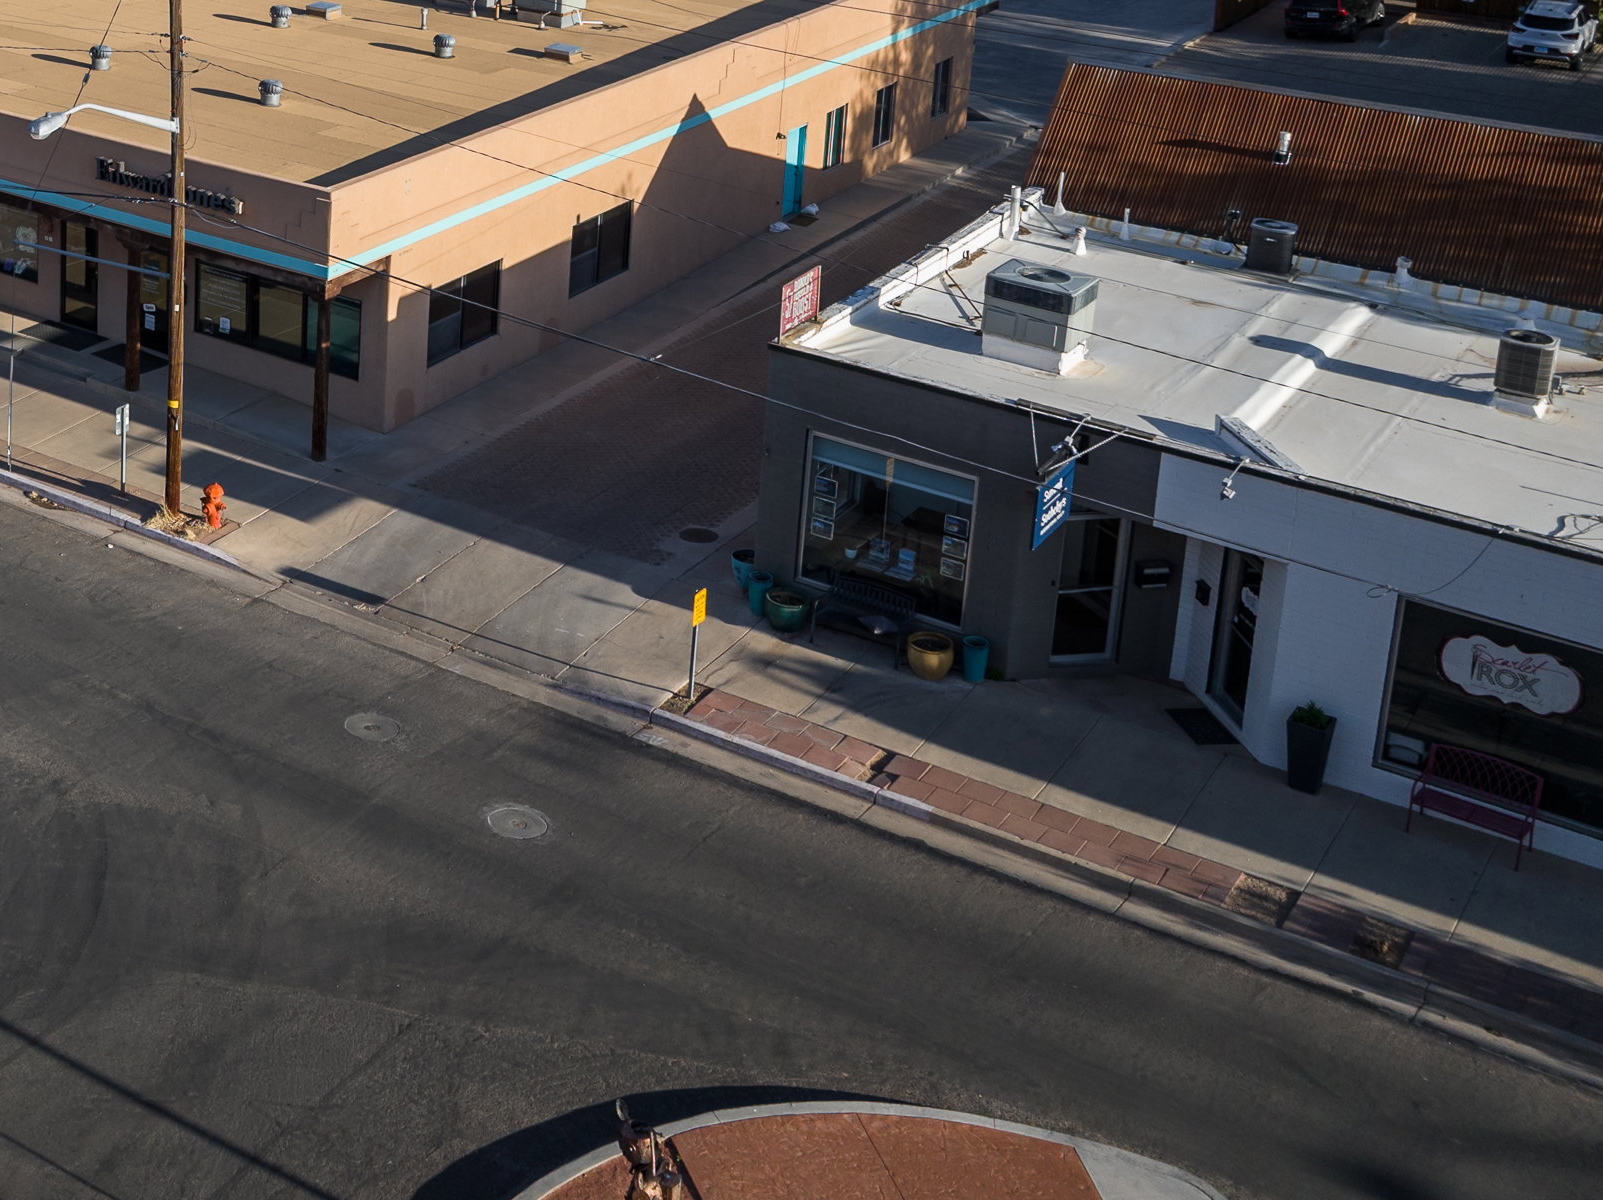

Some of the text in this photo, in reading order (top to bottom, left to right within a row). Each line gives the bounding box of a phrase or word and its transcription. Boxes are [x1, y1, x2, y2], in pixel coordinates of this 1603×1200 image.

[95, 156, 241, 216] Edward ones
[1471, 643, 1569, 678] Scarlet
[1476, 661, 1541, 698] ROX
